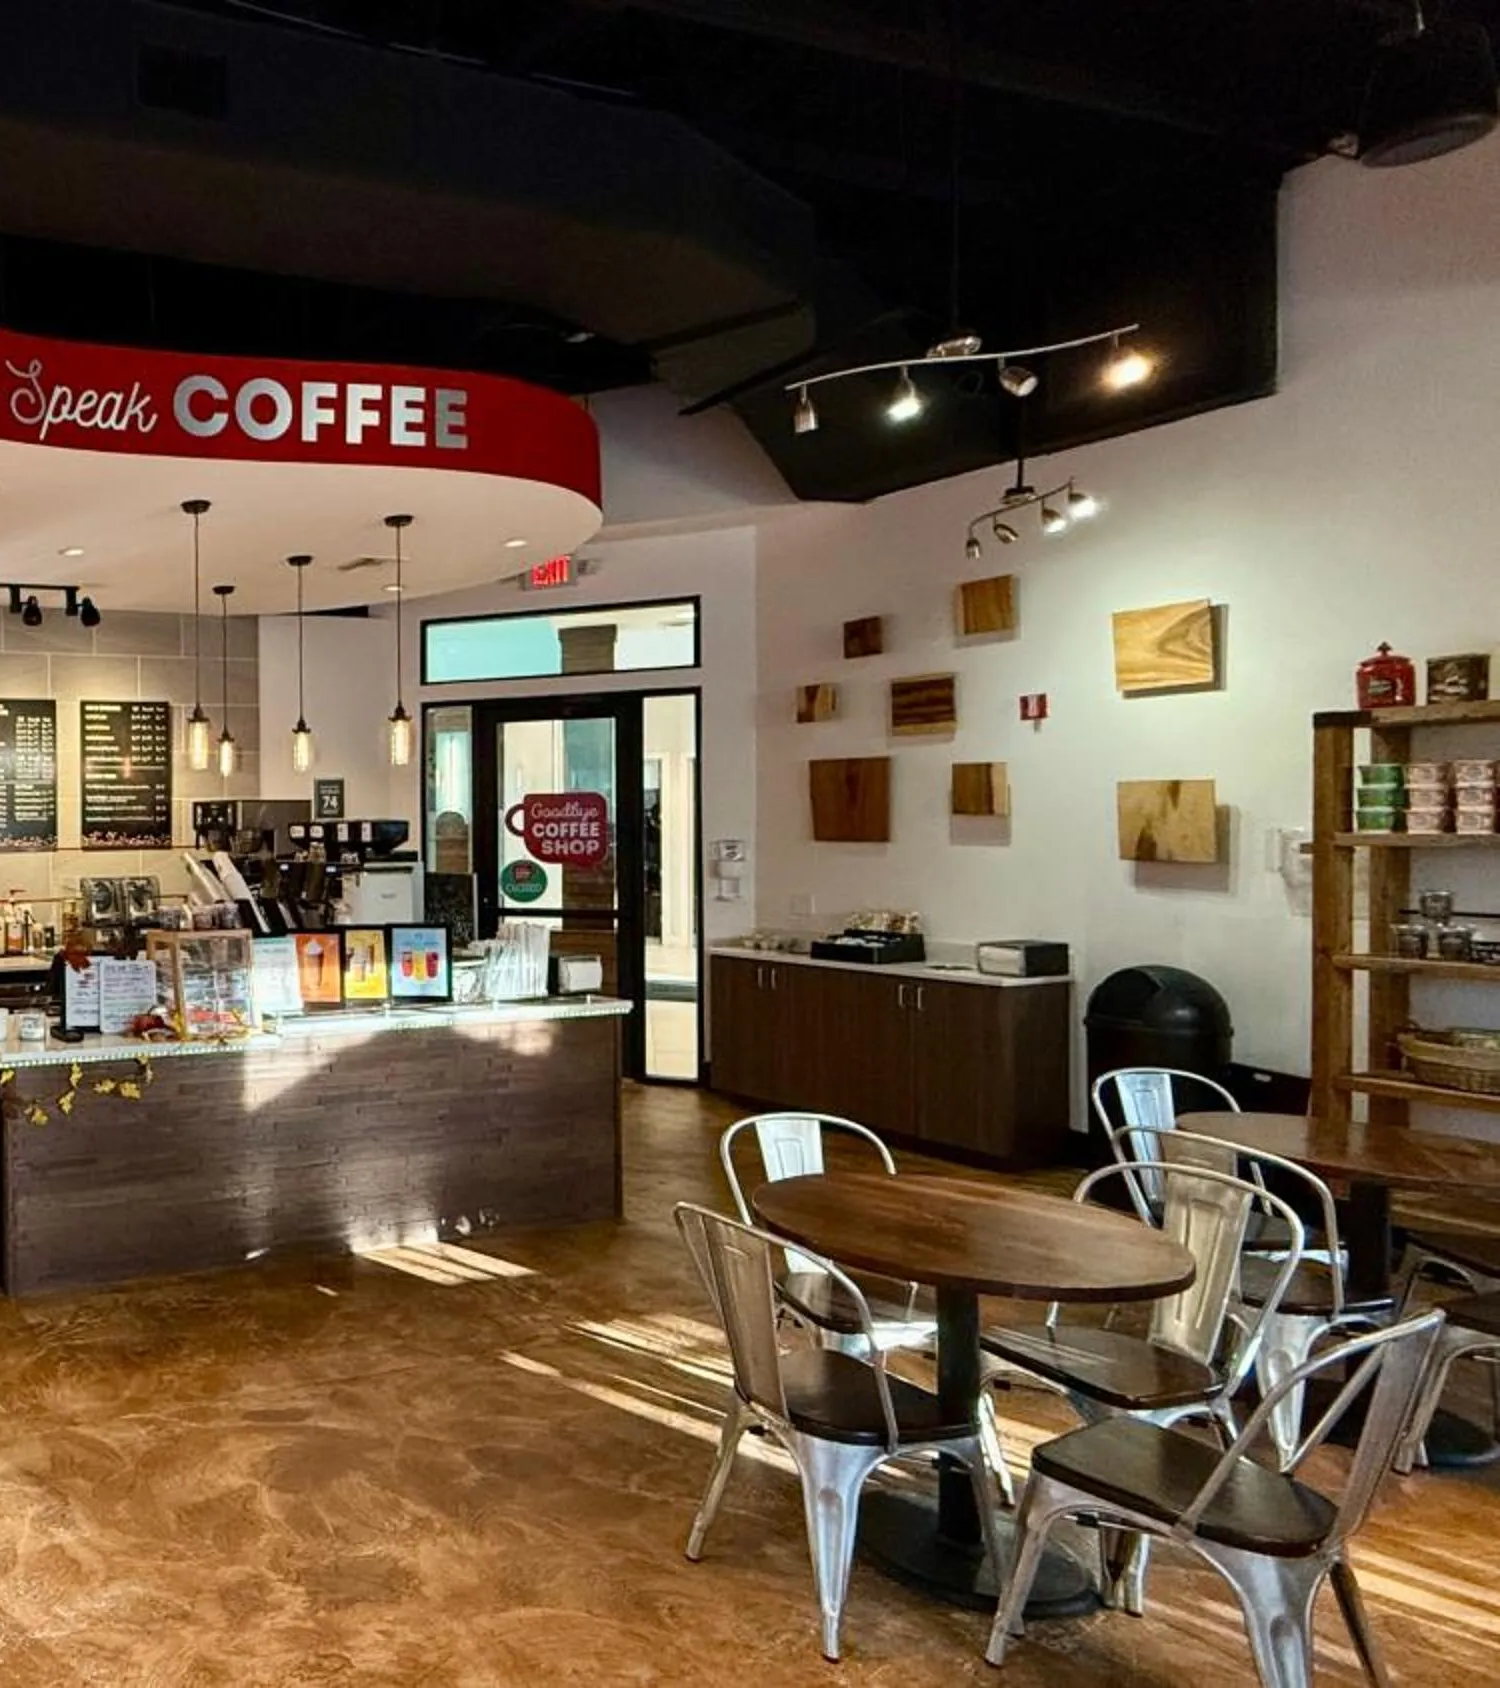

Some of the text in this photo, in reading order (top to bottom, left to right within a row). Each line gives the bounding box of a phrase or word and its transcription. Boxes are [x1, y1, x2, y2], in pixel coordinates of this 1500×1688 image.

[5, 359, 157, 441] Speak
[173, 375, 468, 449] COFFEE
[532, 556, 571, 585] EXIT
[531, 801, 598, 824] Goodbye
[531, 822, 601, 838] COFFEE
[541, 839, 600, 855] SHOP
